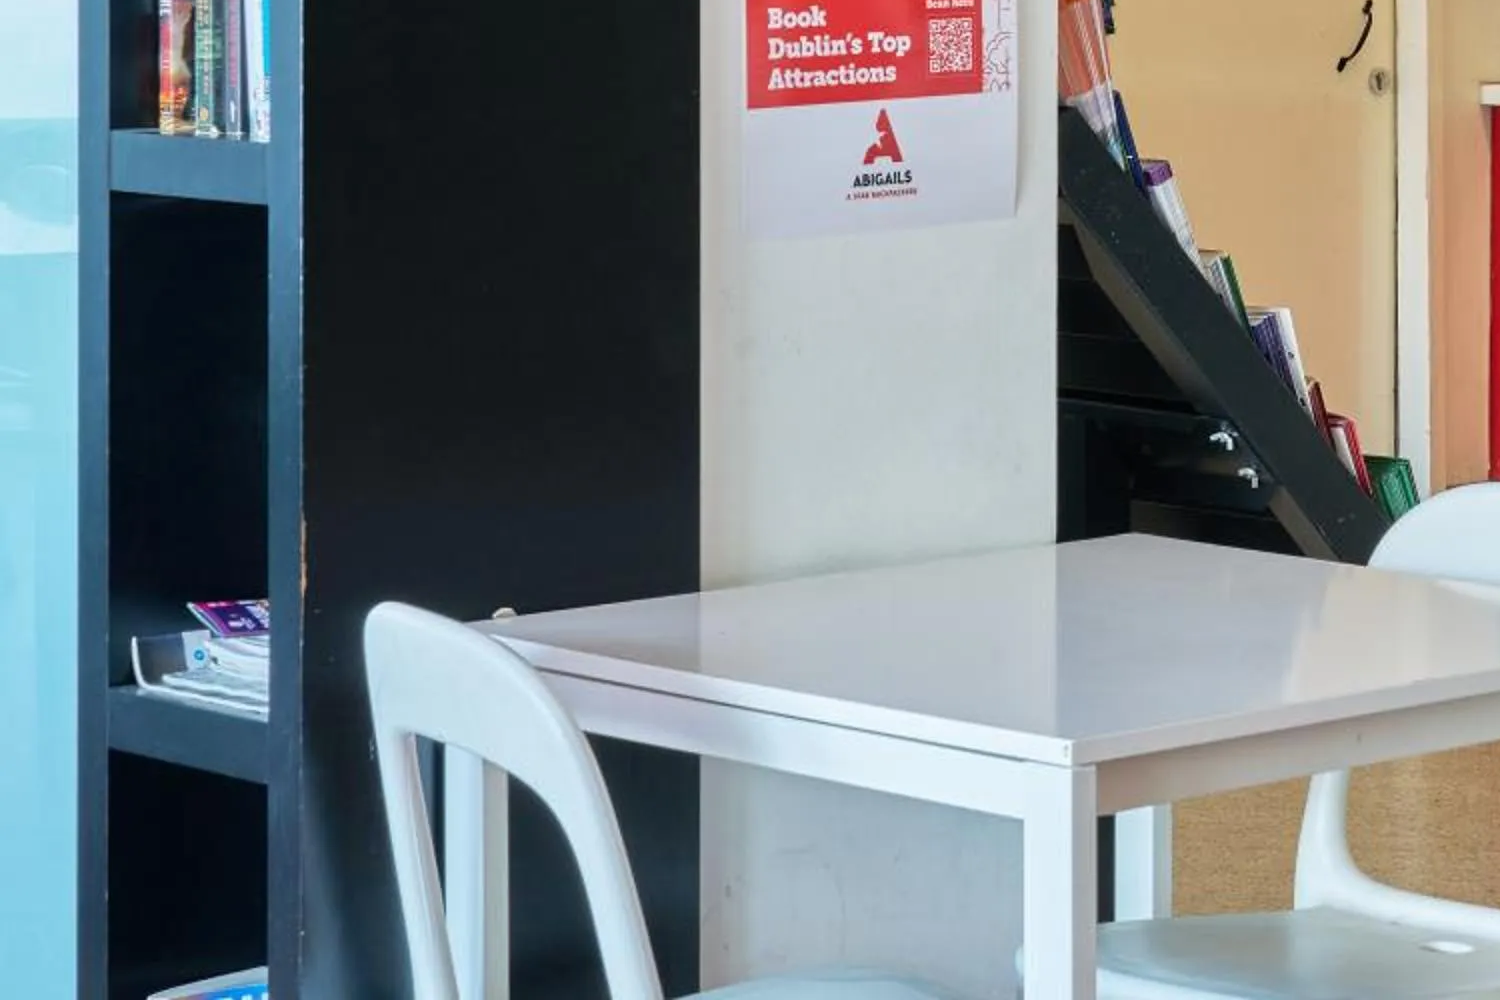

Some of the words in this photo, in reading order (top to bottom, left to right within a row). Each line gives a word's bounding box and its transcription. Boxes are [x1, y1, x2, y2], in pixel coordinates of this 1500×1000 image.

[767, 4, 827, 29] Book
[767, 33, 863, 60] Dublin's
[868, 32, 911, 56] Top
[767, 64, 897, 90] Attractions
[853, 170, 912, 187] ABIGAILS
